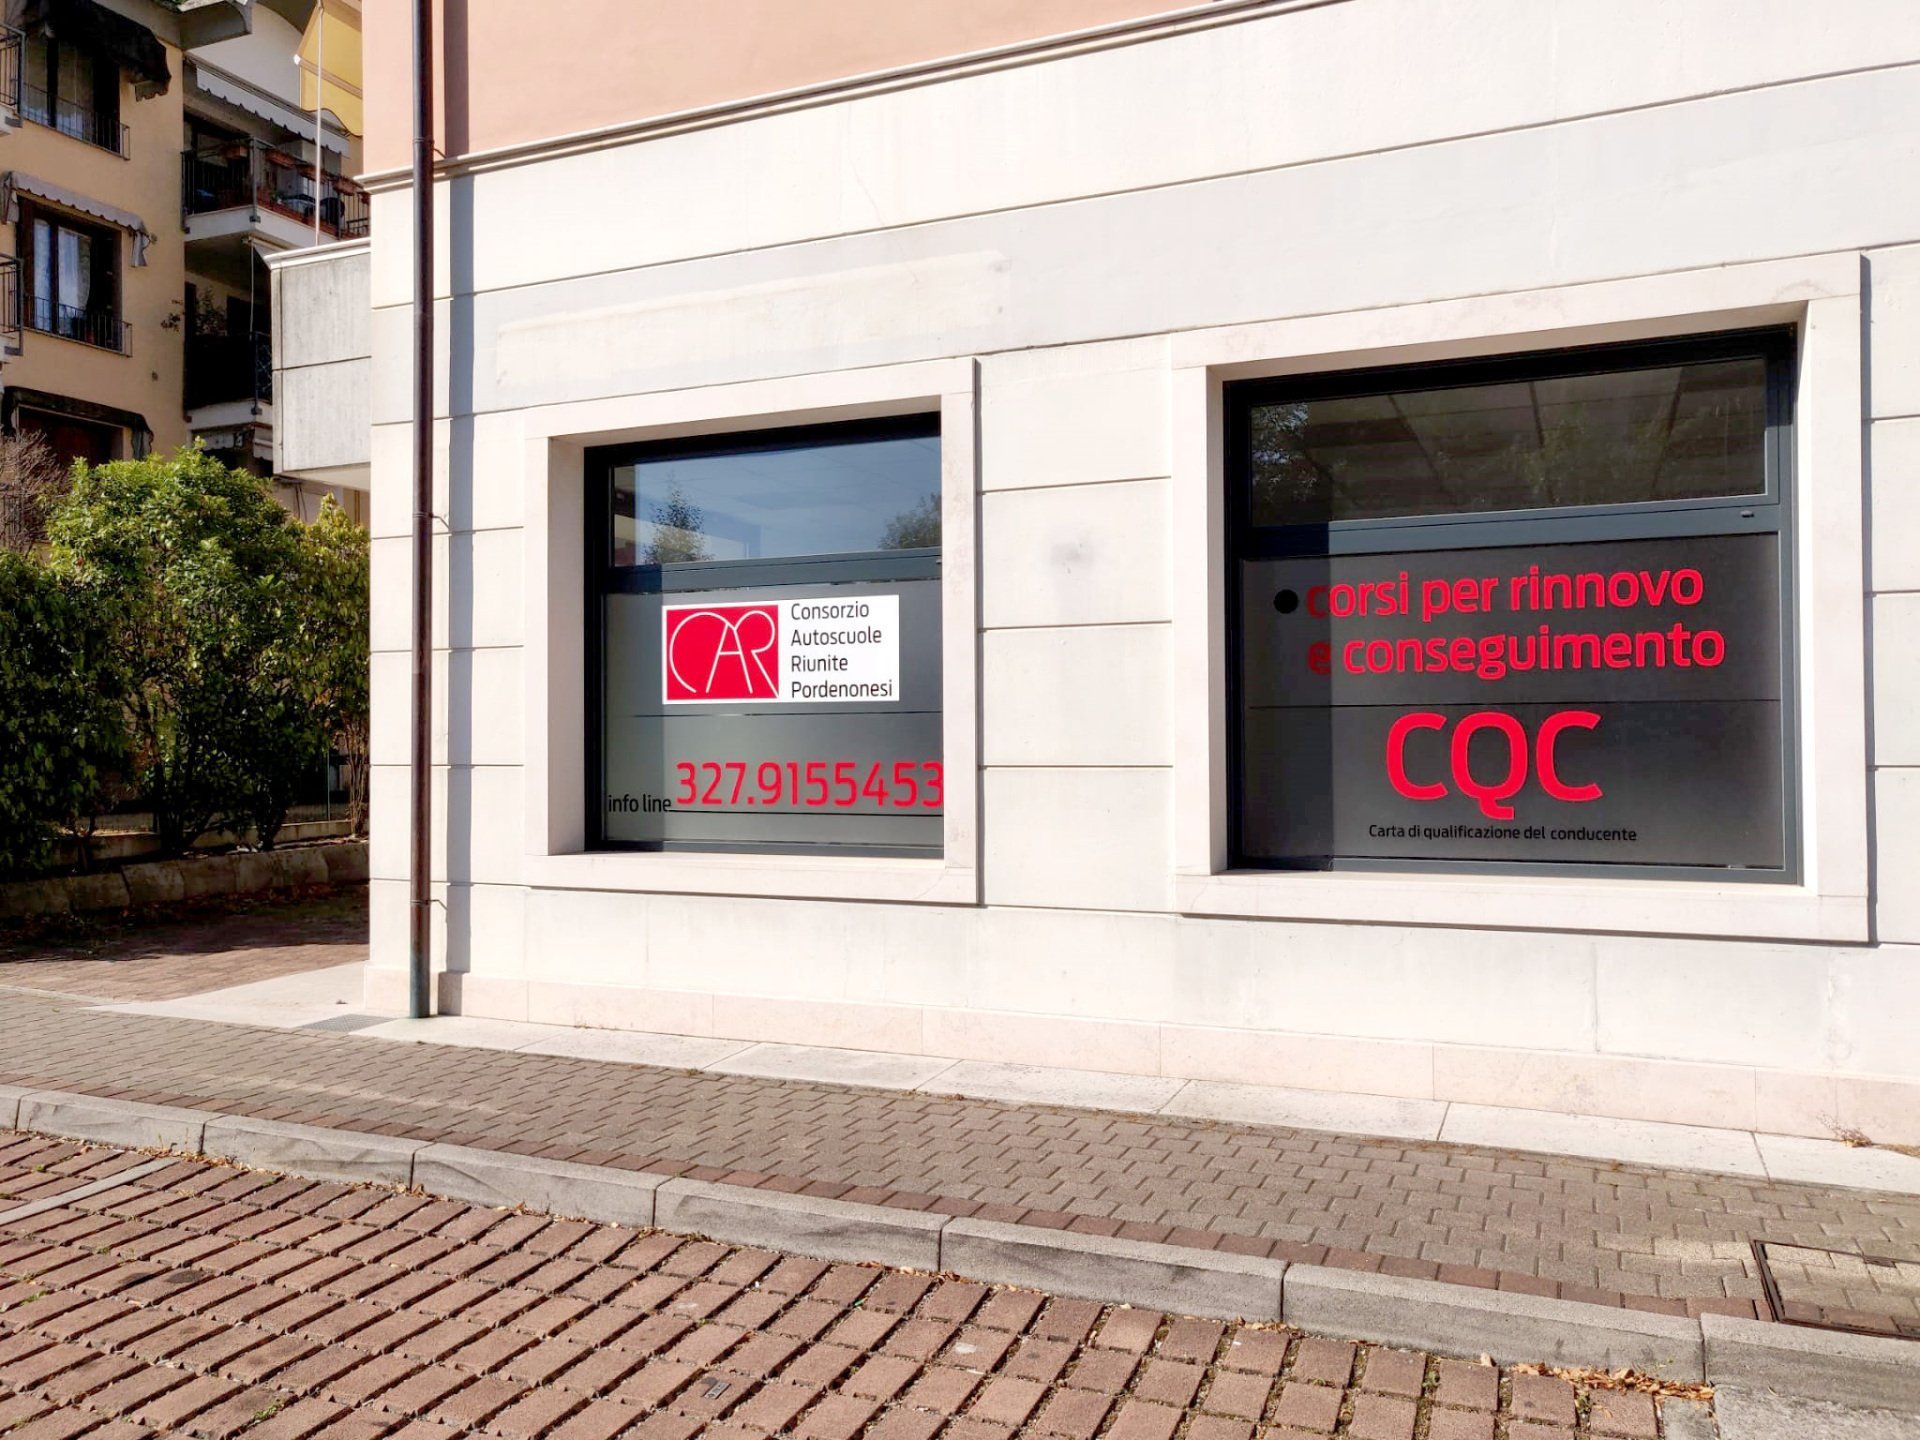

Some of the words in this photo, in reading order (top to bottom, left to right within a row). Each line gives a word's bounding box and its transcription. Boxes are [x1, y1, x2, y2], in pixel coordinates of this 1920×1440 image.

[1306, 571, 1408, 619] corsi
[1422, 577, 1499, 622] per
[1510, 565, 1703, 611] rinnovo
[791, 601, 869, 620] Consorzio
[791, 625, 882, 646] Autoscuole
[1307, 641, 1331, 675] e
[1343, 622, 1725, 680] conseguimento
[791, 654, 848, 672] Riunite
[791, 680, 892, 698] Pordenonesi
[1386, 711, 1603, 820] CQC
[608, 794, 639, 812] info
[642, 794, 671, 812] line
[675, 761, 943, 807] 327.9155453
[1369, 824, 1405, 838] Carta
[1408, 825, 1420, 838] di
[1423, 825, 1520, 840] qualificazione
[1524, 826, 1546, 839] del
[1551, 827, 1637, 841] conducente
